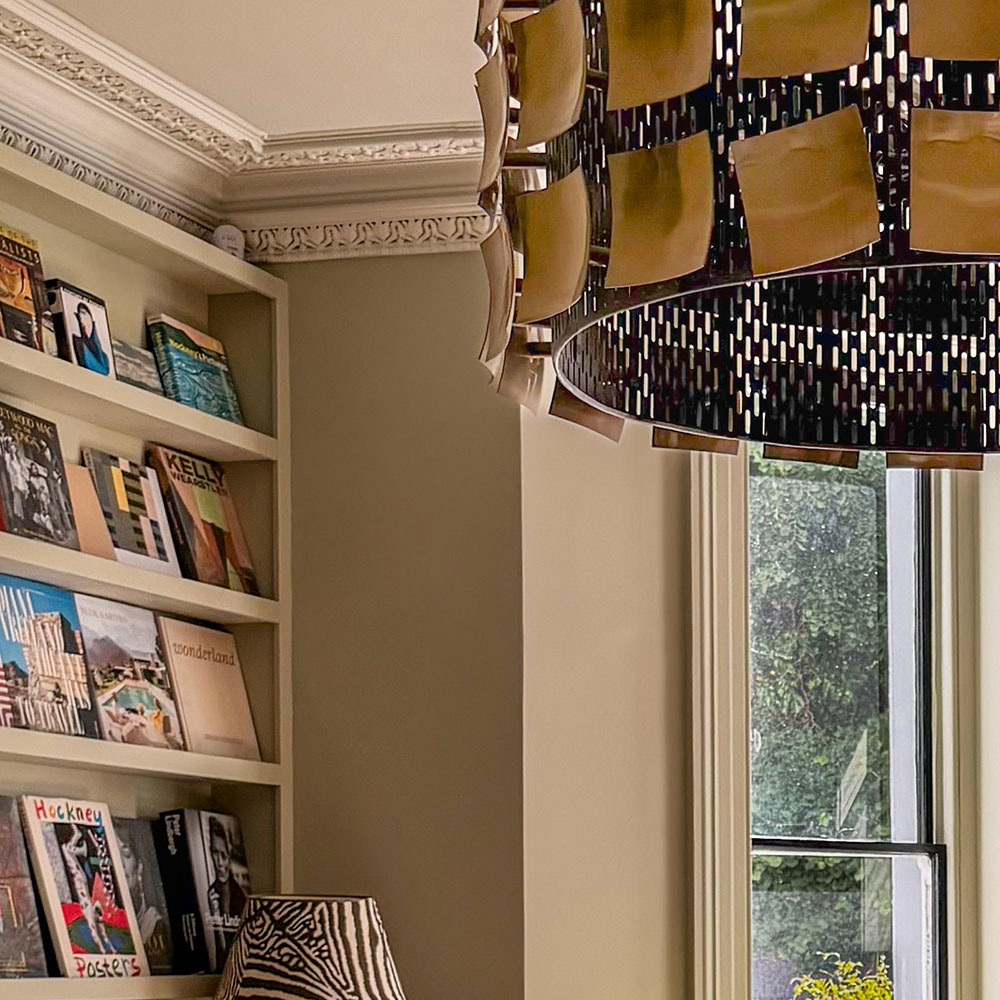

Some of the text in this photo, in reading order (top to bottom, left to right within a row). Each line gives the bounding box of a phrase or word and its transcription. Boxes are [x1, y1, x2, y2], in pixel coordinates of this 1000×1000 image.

[163, 452, 226, 487] KELLY
[172, 642, 236, 666] wonderland
[33, 798, 103, 834] Hockney
[73, 956, 142, 978] Posters
